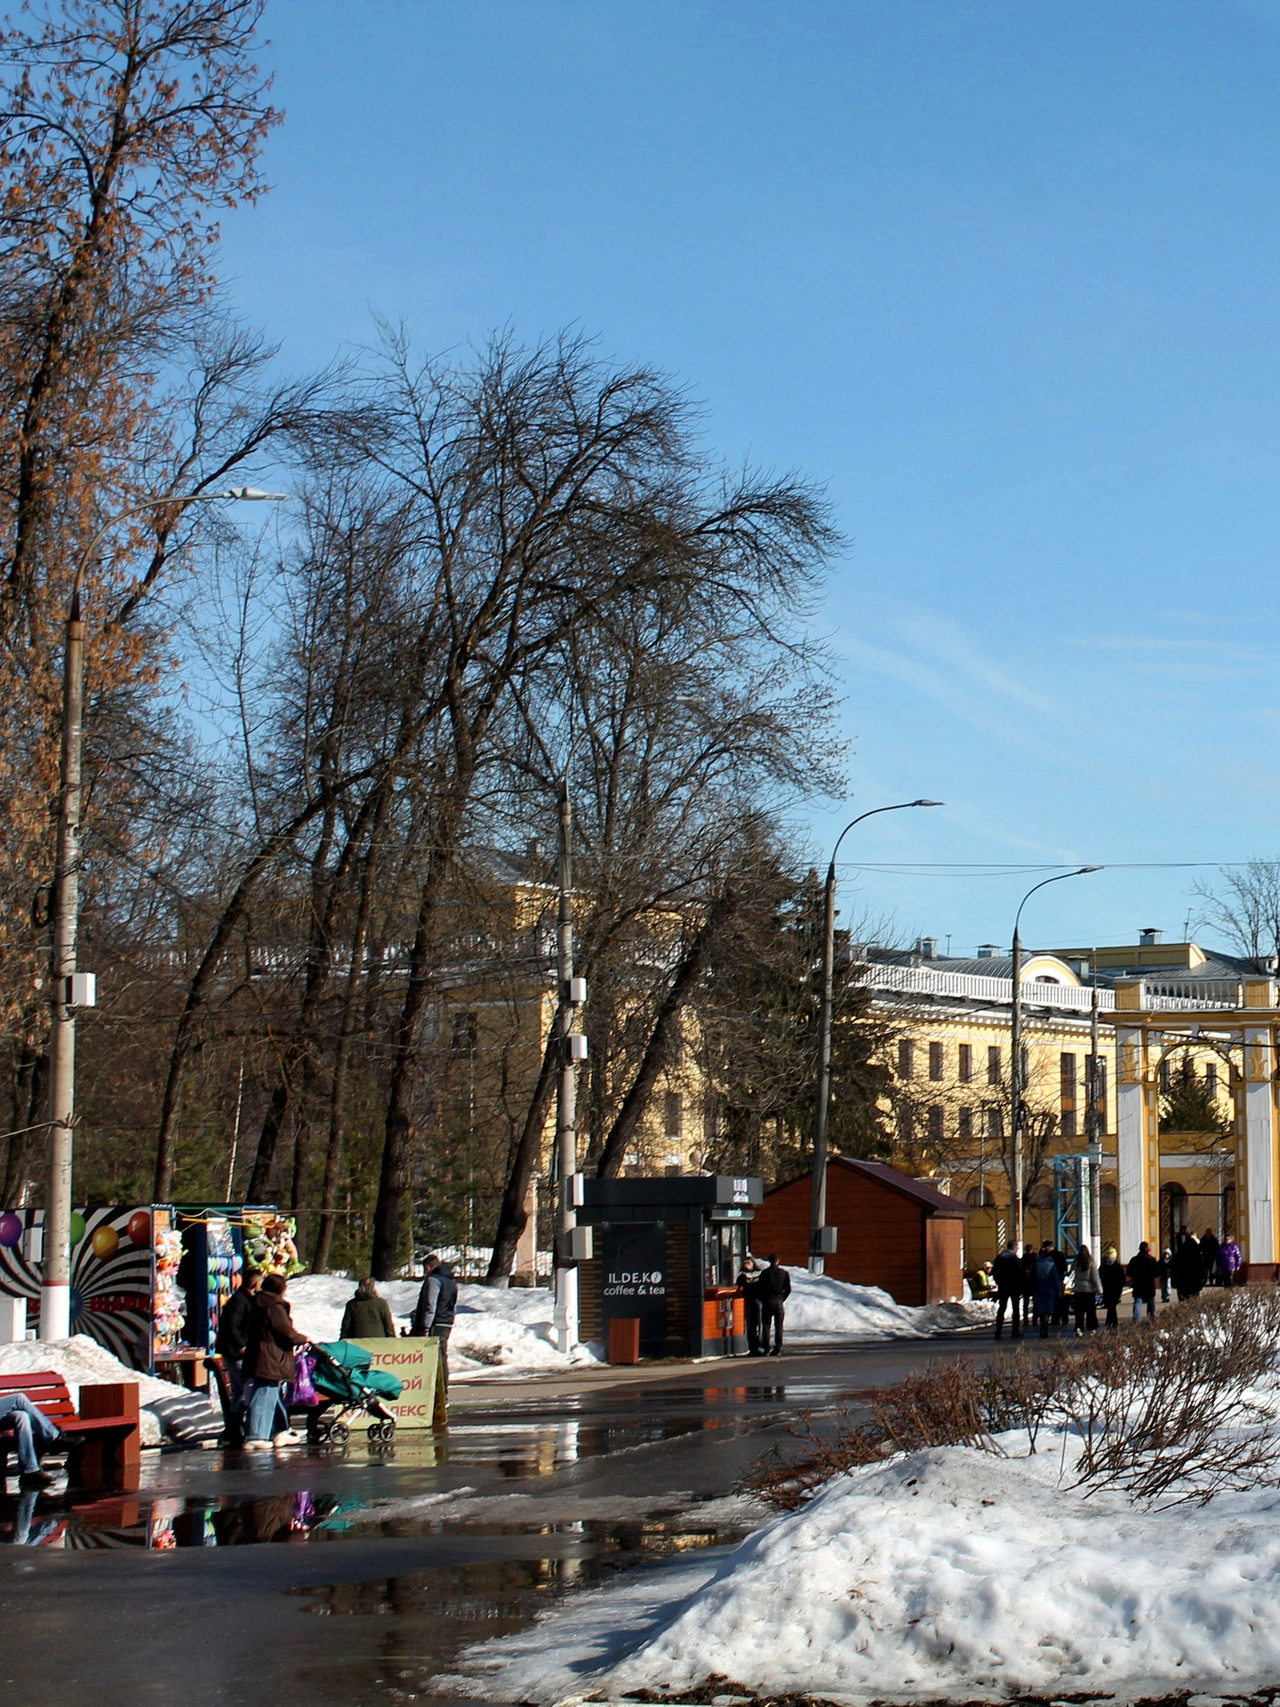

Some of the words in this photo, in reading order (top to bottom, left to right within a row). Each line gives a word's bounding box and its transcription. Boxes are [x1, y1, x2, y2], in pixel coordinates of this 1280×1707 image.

[604, 1284, 635, 1296] coffee
[637, 1285, 647, 1295] &
[649, 1285, 665, 1295] tea
[371, 1349, 424, 1365] ТСКИЙ
